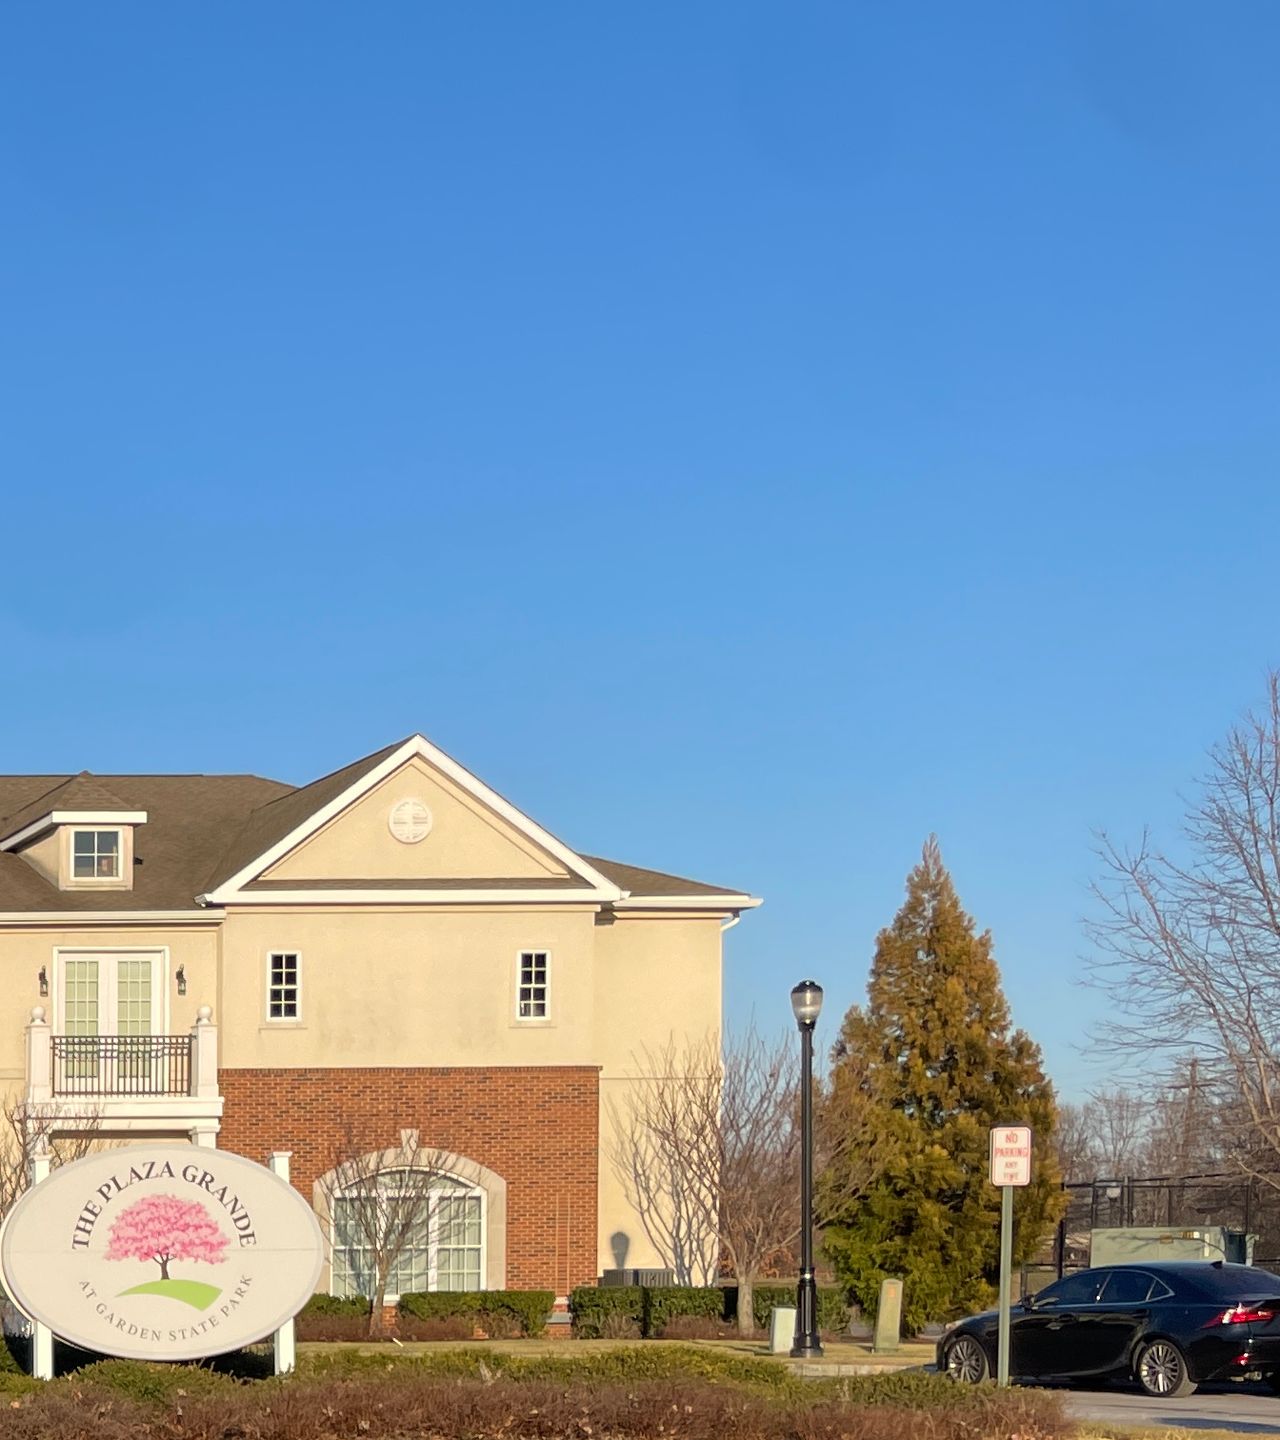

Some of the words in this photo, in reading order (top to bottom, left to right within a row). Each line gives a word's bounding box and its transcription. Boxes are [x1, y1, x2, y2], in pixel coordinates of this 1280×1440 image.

[995, 1148, 1029, 1157] PARKING
[1005, 1133, 1018, 1143] NO
[72, 1200, 102, 1249] THE
[96, 1161, 175, 1202] PLAZA
[182, 1165, 256, 1247] GRANDE
[79, 1280, 97, 1300] AT
[96, 1303, 161, 1341] GARDEN
[169, 1317, 219, 1341] STATE
[220, 1274, 252, 1317] PARK
